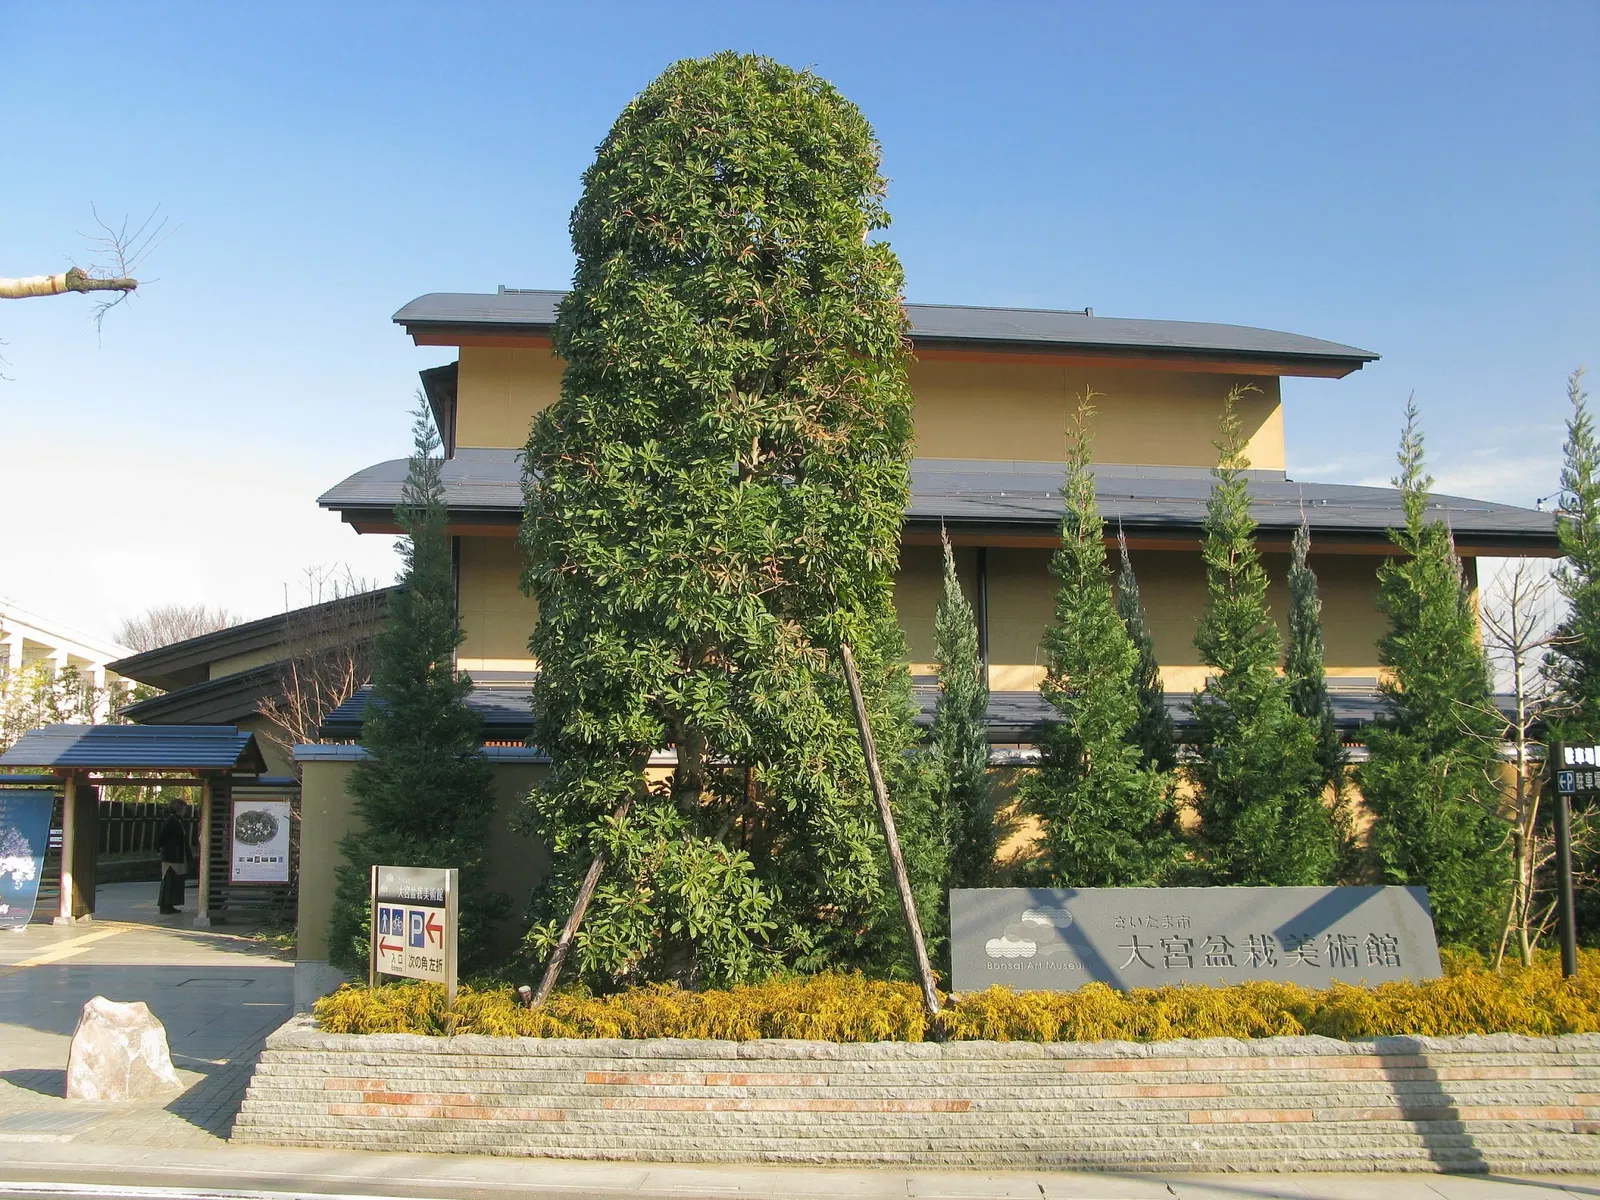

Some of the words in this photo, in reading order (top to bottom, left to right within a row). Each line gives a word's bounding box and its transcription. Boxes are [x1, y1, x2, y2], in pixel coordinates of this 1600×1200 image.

[1114, 915, 1191, 929] さいたま市
[411, 914, 423, 945] P
[1117, 933, 1401, 969] 大宮盆栽美術館
[391, 953, 403, 964] 入口
[987, 961, 1024, 970] Bonsai
[1027, 961, 1042, 970] Art
